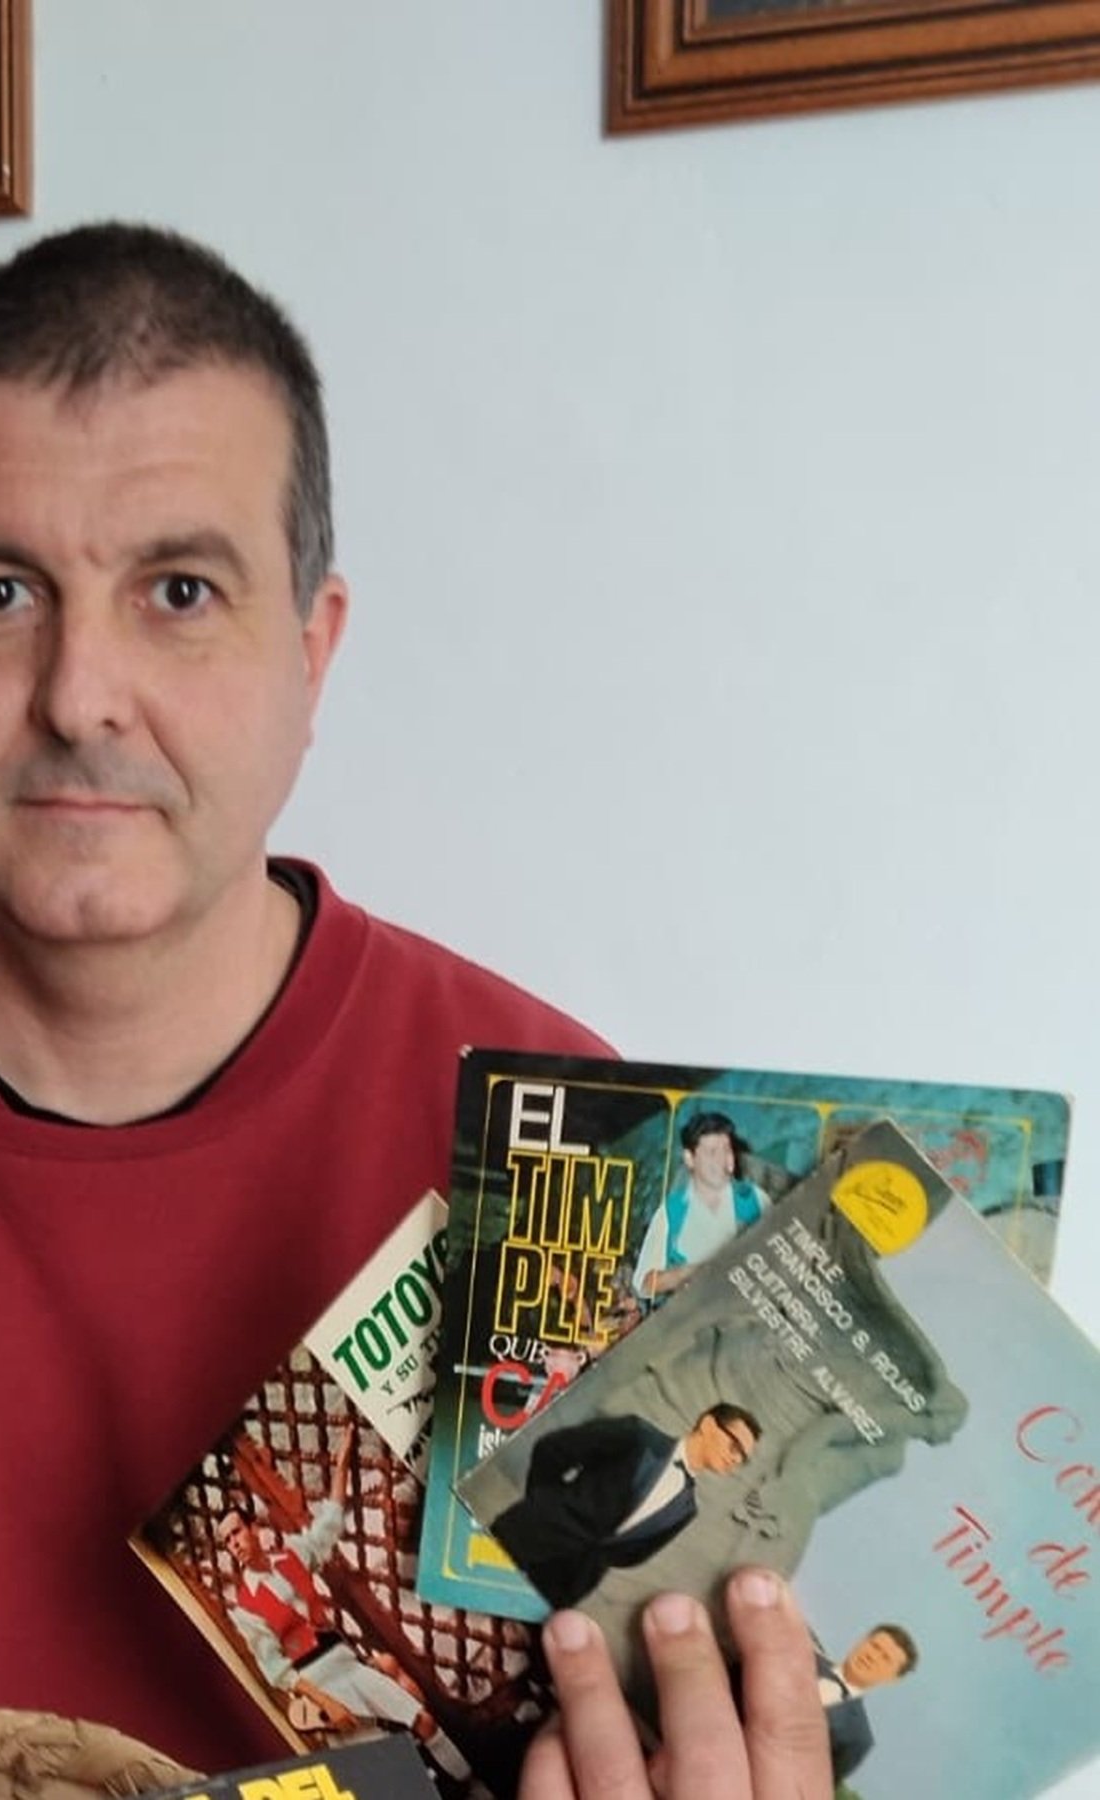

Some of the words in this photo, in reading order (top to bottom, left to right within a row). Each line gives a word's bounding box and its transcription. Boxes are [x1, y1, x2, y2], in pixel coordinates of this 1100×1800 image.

[508, 1082, 590, 1156] EL
[508, 1152, 632, 1254] TIM
[495, 1242, 615, 1344] PLE
[727, 1266, 814, 1361] SILVESTRE
[766, 1233, 853, 1330] FRANCISCO
[870, 1351, 927, 1412] ROJAS
[933, 1505, 1070, 1677] Timple
[1028, 1543, 1090, 1601] de
